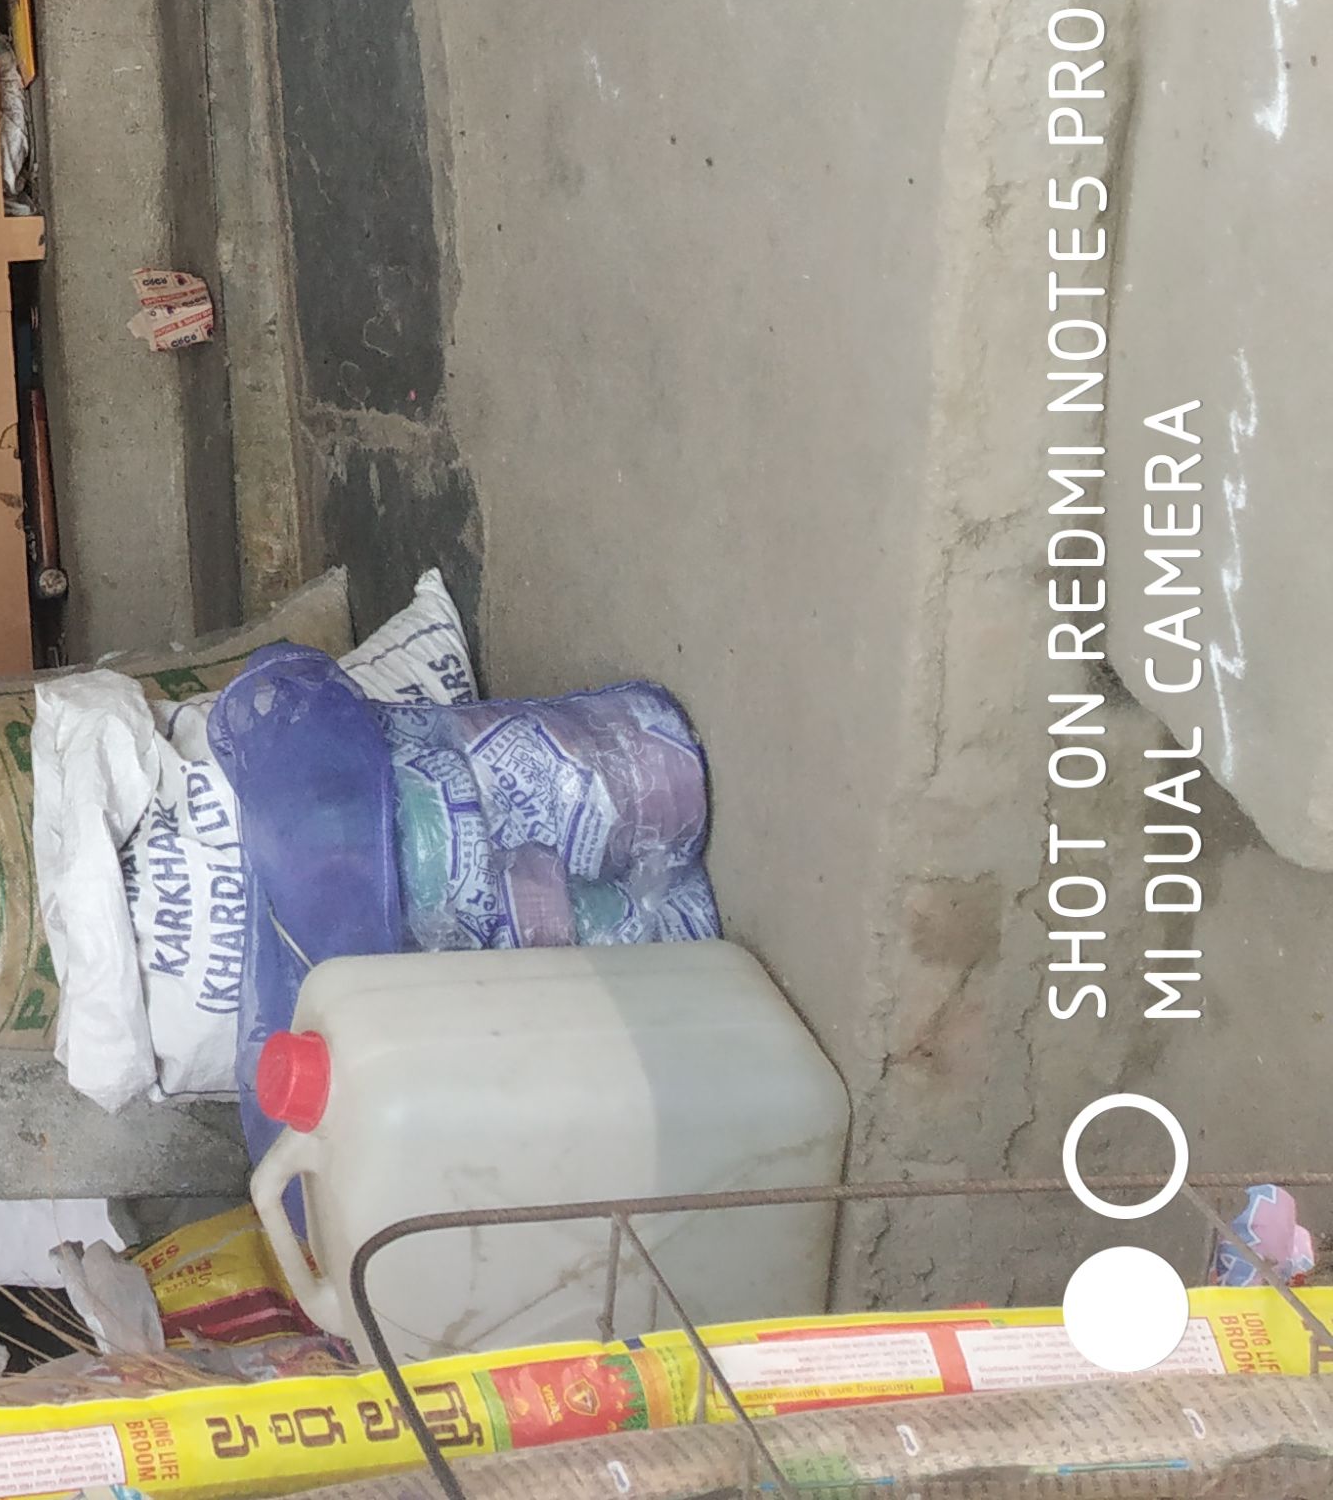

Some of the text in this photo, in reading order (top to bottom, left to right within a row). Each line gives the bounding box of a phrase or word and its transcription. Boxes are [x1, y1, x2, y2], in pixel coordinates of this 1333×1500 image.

[125, 1420, 158, 1483] BROOM
[146, 1417, 180, 1481] LONG LIFE
